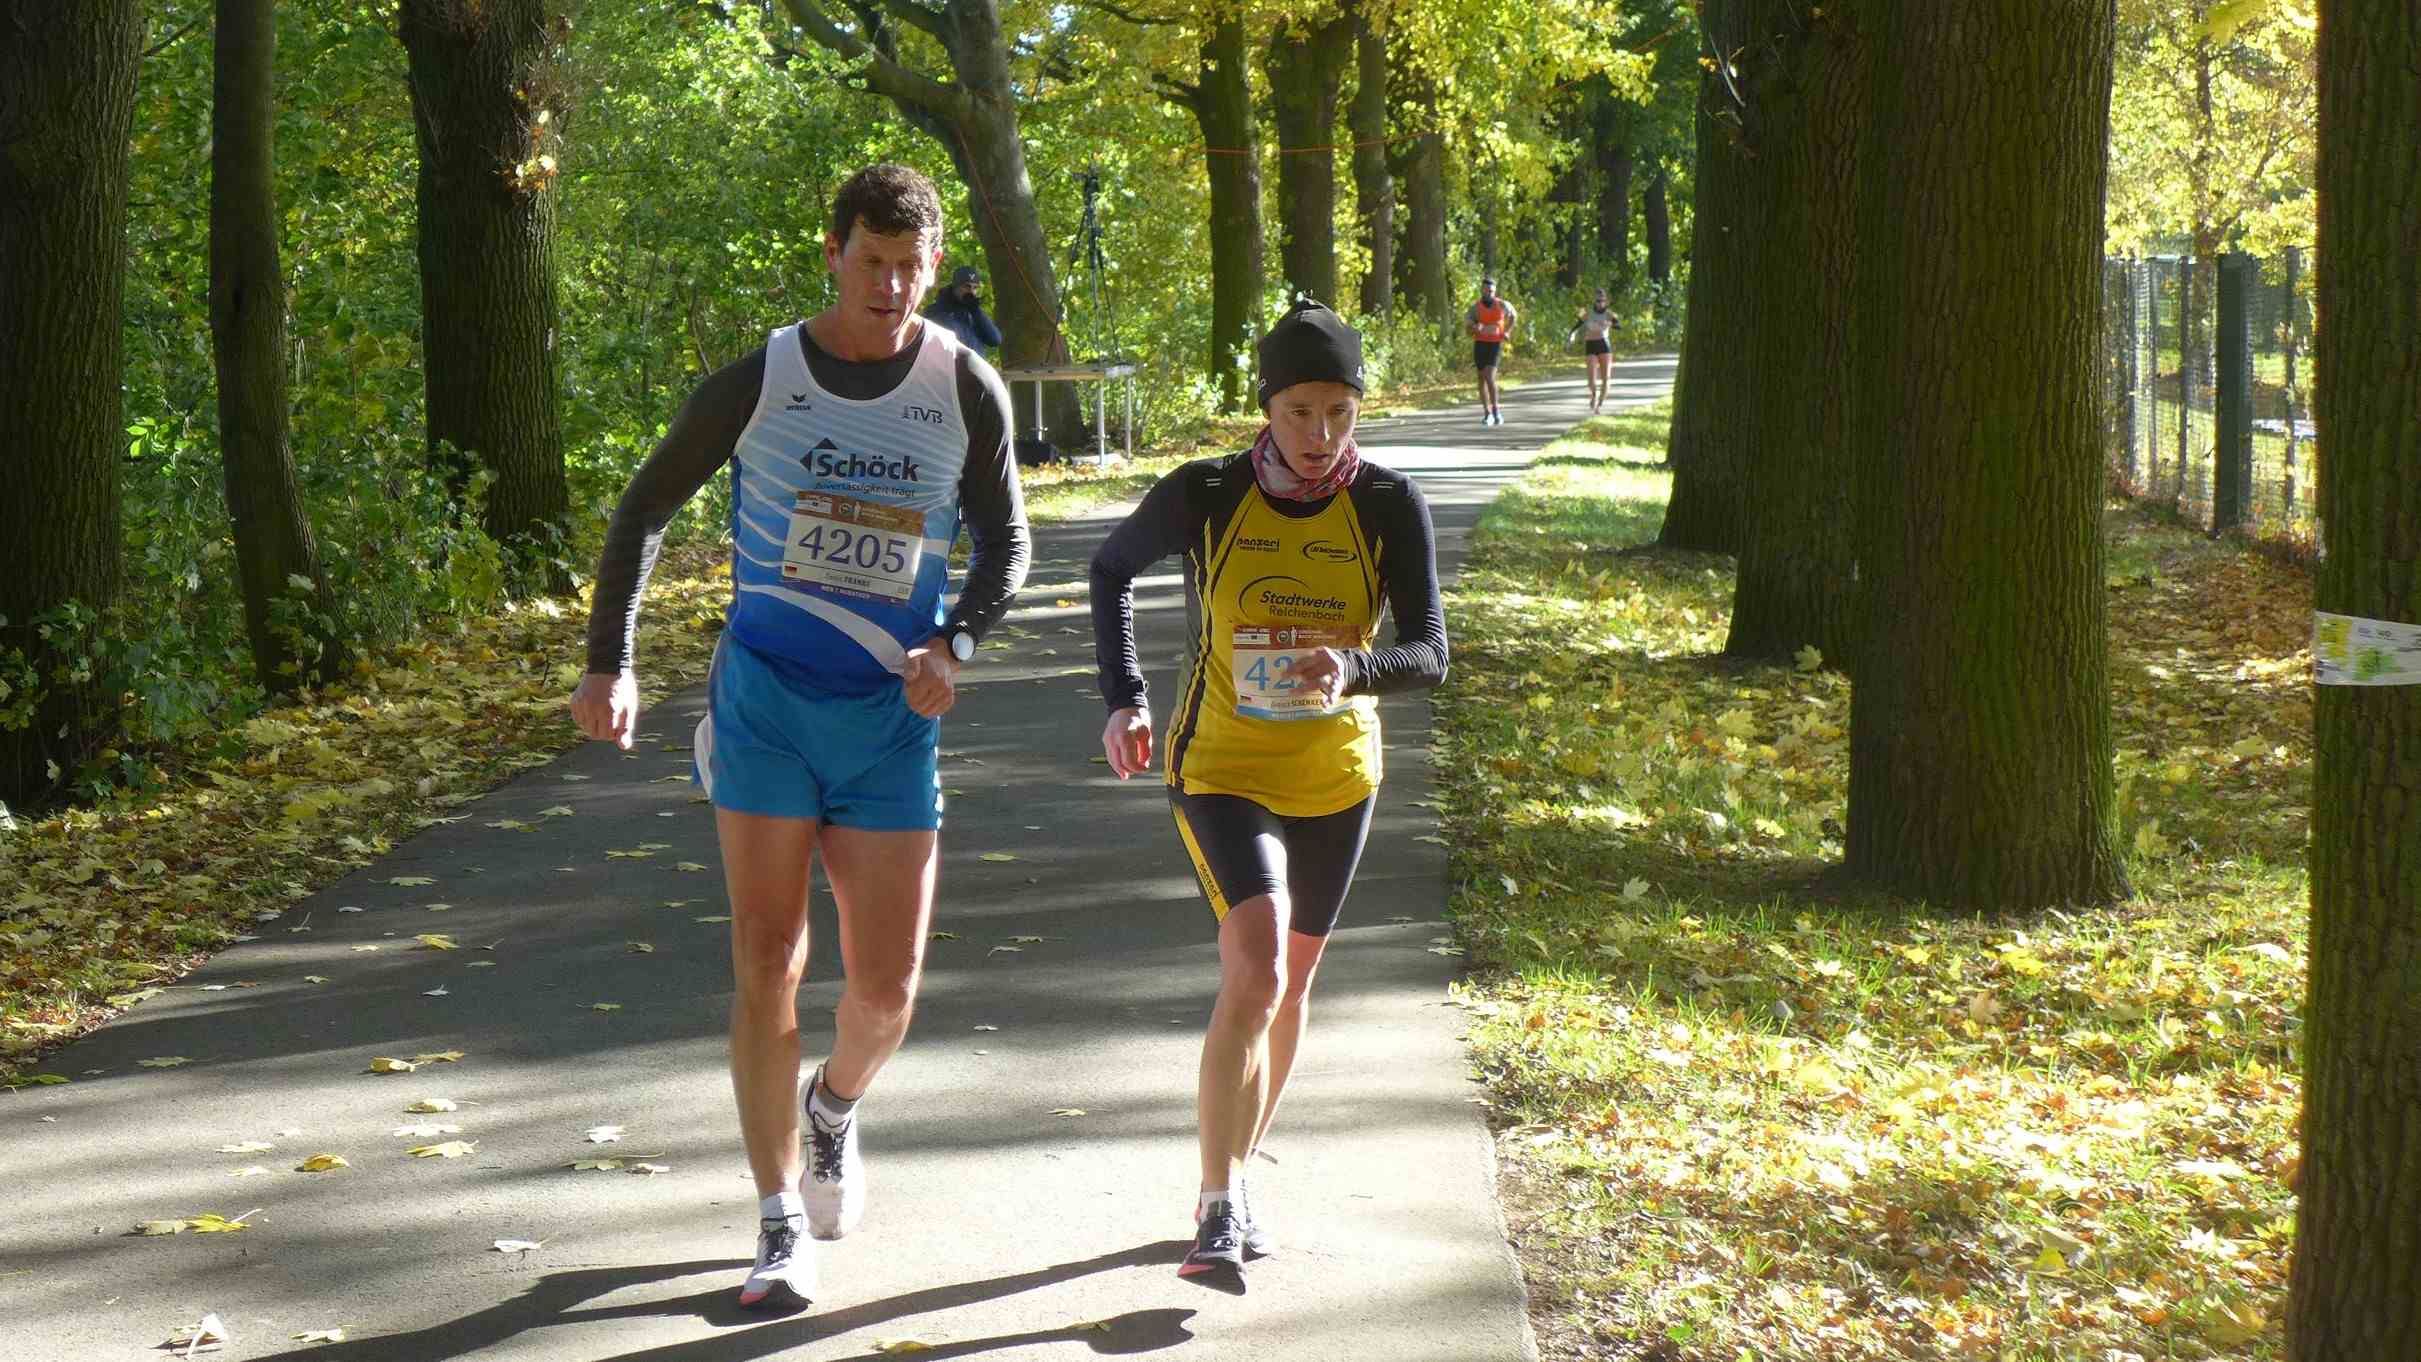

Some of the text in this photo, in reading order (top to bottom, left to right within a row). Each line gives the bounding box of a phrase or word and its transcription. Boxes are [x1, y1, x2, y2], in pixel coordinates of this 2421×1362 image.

[815, 453, 919, 481] Schöck
[798, 525, 907, 573] 4205
[1260, 590, 1346, 610] Stadtwerke
[1269, 605, 1345, 622] Reichenbach
